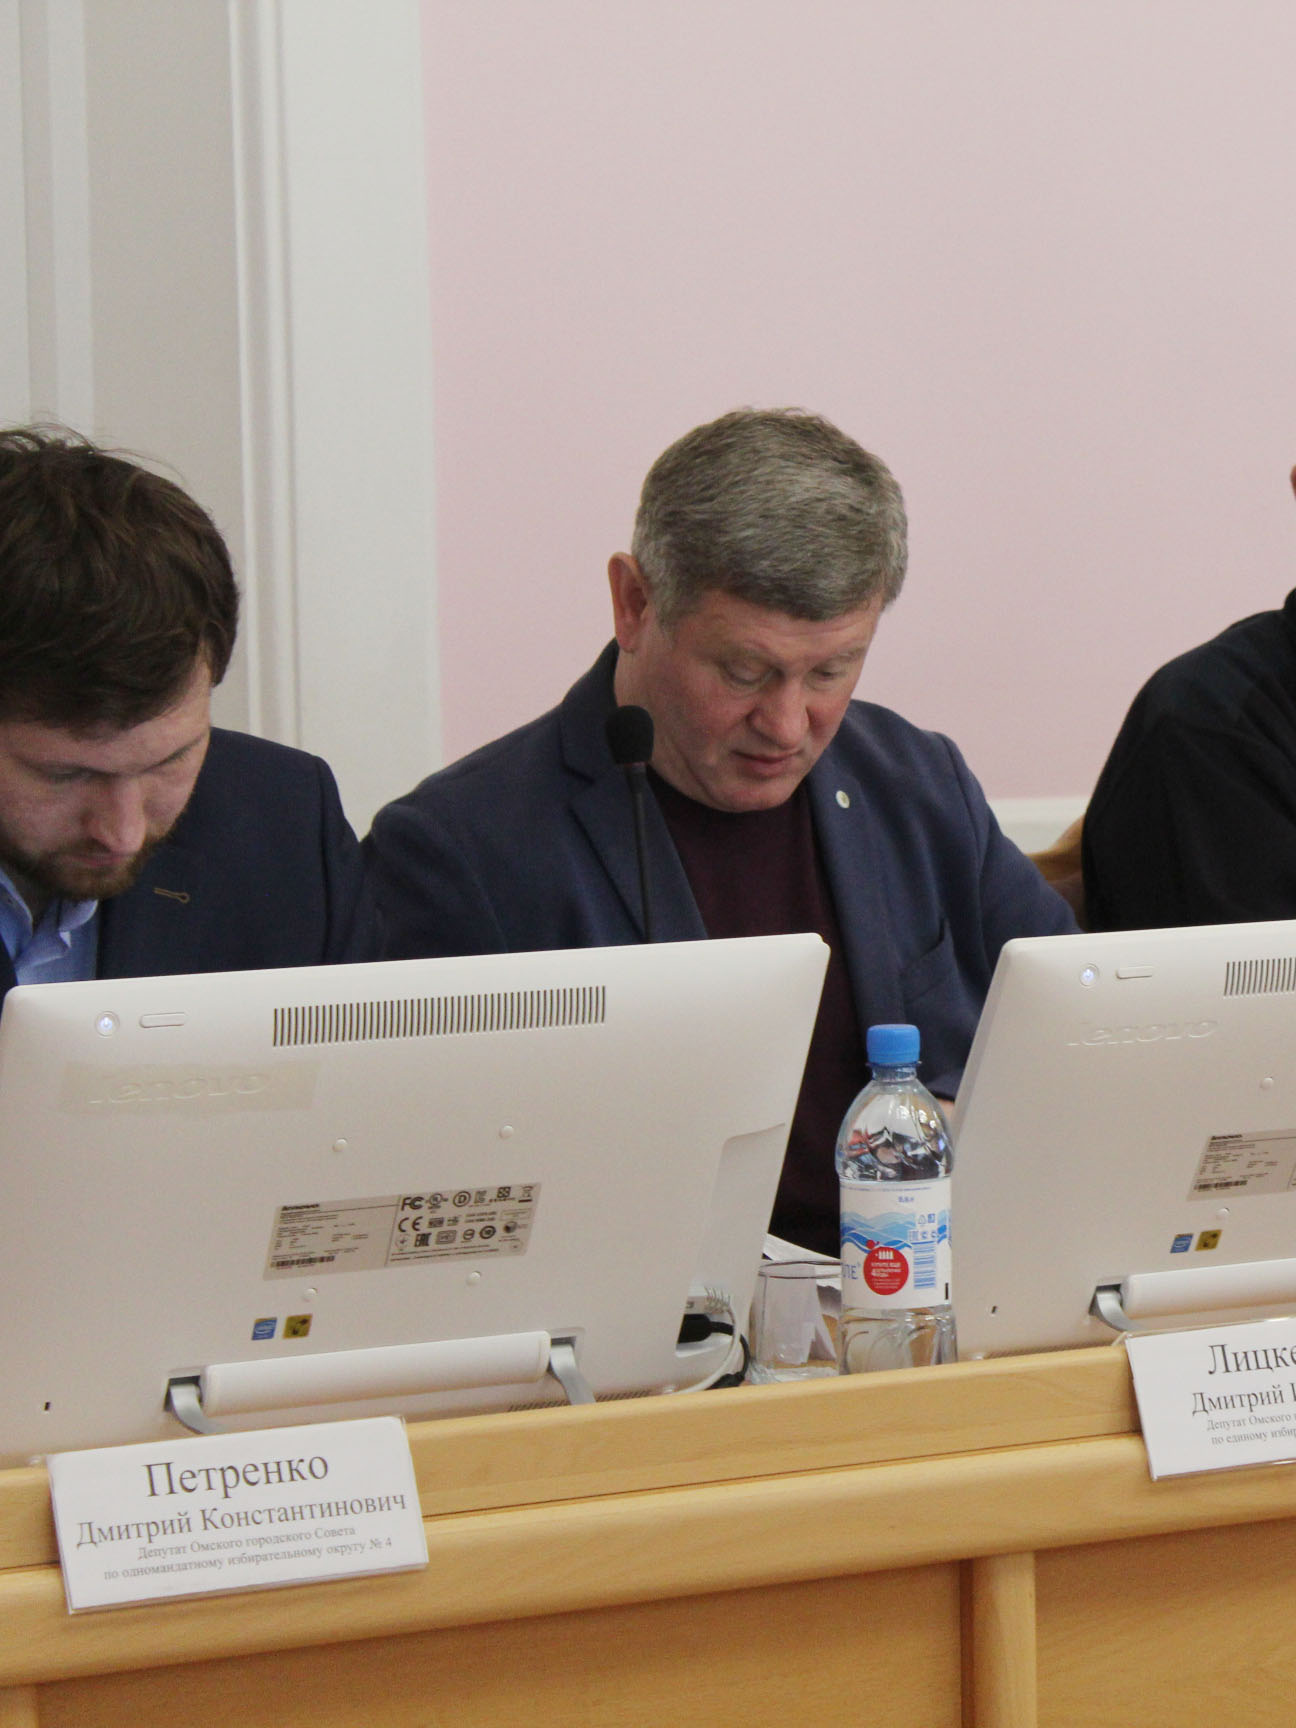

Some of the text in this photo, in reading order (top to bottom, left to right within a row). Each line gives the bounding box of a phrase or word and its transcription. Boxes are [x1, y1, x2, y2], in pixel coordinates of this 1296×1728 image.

[1192, 1384, 1284, 1416] Дмитрий
[1206, 1416, 1247, 1431] Депутат
[1249, 1412, 1292, 1426] Омского
[1211, 1435, 1224, 1445] по
[1226, 1430, 1269, 1444] единому
[142, 1455, 329, 1500] Петренко
[76, 1493, 407, 1549] Дмитрий Константинович
[103, 1537, 393, 1580] по одномандатному избирательному округу № 4
[137, 1525, 356, 1560] Депутат Омского городского Совета
